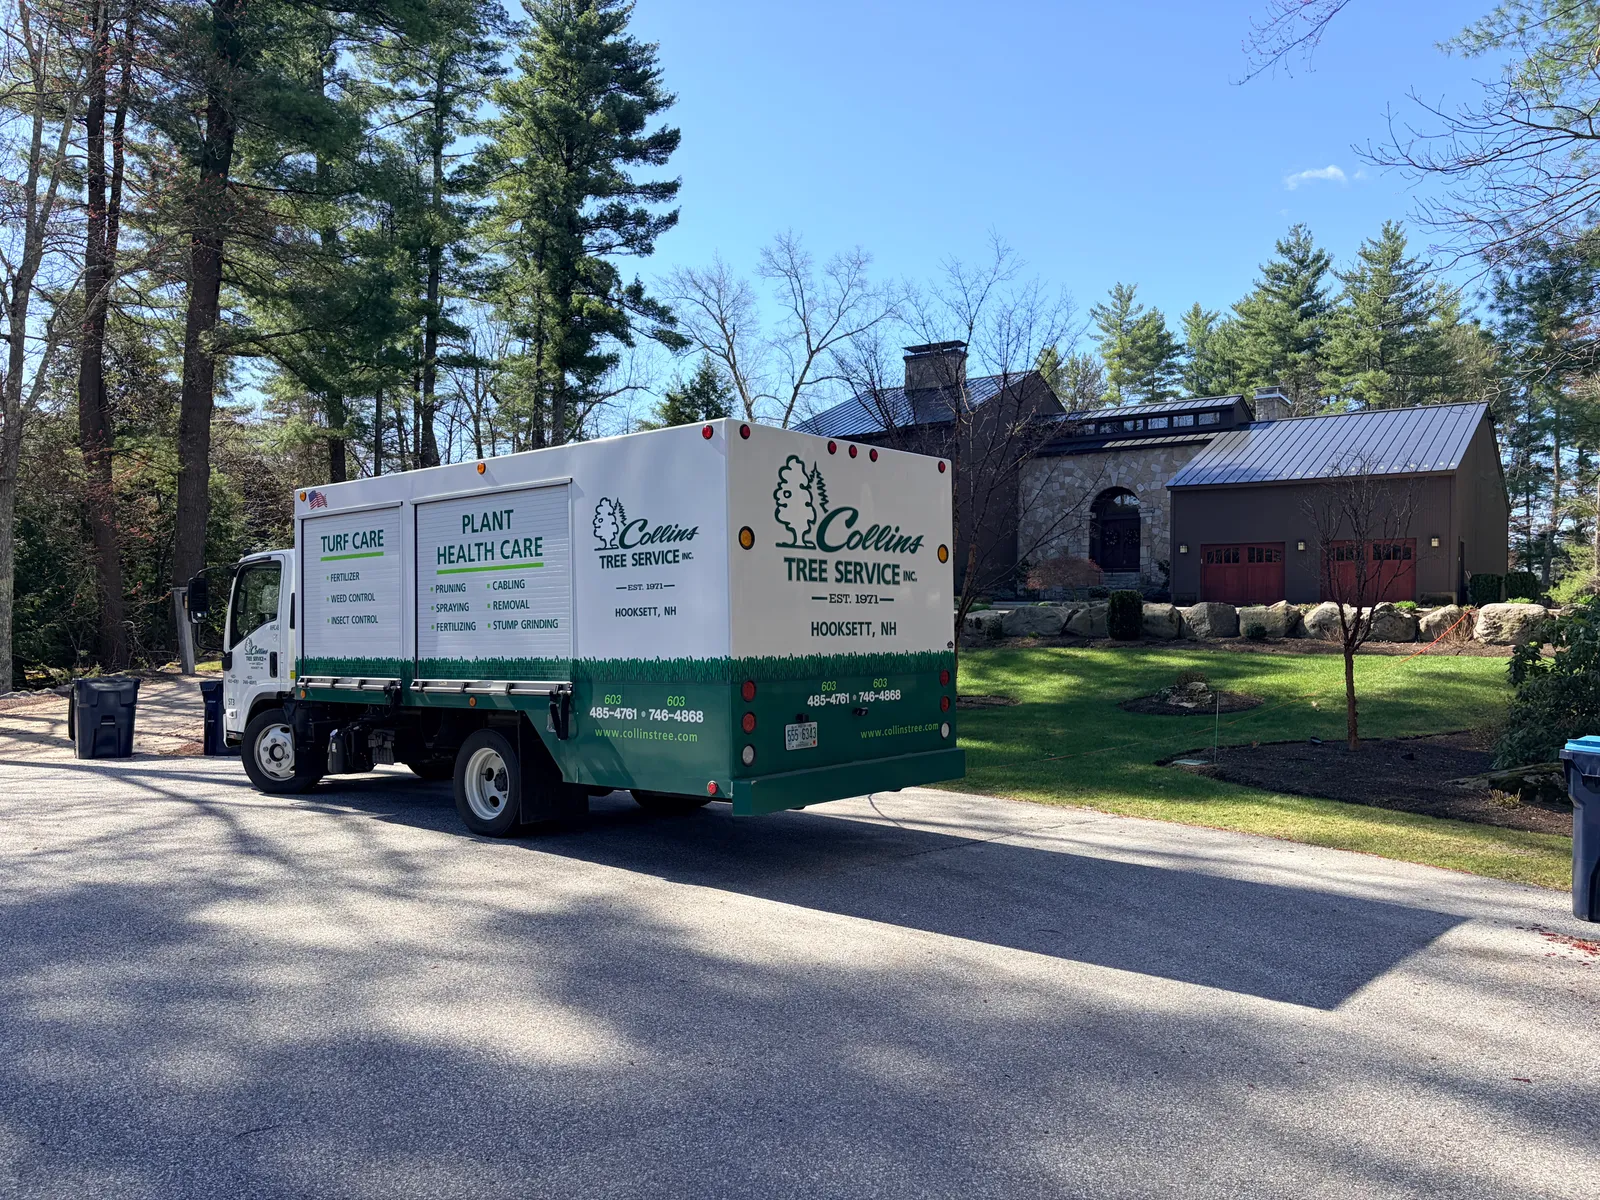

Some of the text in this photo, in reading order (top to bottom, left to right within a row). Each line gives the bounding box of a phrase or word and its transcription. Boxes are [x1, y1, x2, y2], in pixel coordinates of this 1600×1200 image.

[462, 509, 514, 534] PLANT
[618, 518, 699, 550] Collins
[816, 506, 924, 554] Collins
[321, 529, 384, 553] TURF CARE
[437, 536, 543, 565] HEALTH CARE
[599, 552, 627, 569] TREE
[632, 549, 680, 567] SERVICE
[330, 571, 360, 582] FERTILIZER
[784, 557, 918, 585] TREE SERVICE INC.
[436, 583, 466, 594] PRUNING
[492, 579, 526, 590] CABLING
[628, 582, 664, 592] EST. 1971
[331, 592, 375, 603] WEED CONTROL
[829, 594, 878, 604] EST. 1971
[436, 602, 470, 613] SPRAYING
[493, 600, 530, 610] REMOVAL
[615, 606, 676, 618] HOOKSETT, NH
[331, 614, 378, 624] INSECT CONTROL
[493, 618, 558, 630] STUMP GRINDING
[436, 621, 476, 632] FERTILIZING
[811, 621, 897, 638] HOOKSETT, NH
[821, 678, 888, 692] 603 603
[604, 694, 685, 706] 603 603
[807, 690, 901, 707] 485-4761 746-4868
[590, 707, 704, 722] 485-4761 746-4868
[594, 728, 698, 742] www.collinstree.com
[788, 729, 798, 742] 555
[860, 722, 939, 739] www.collinstree.com
